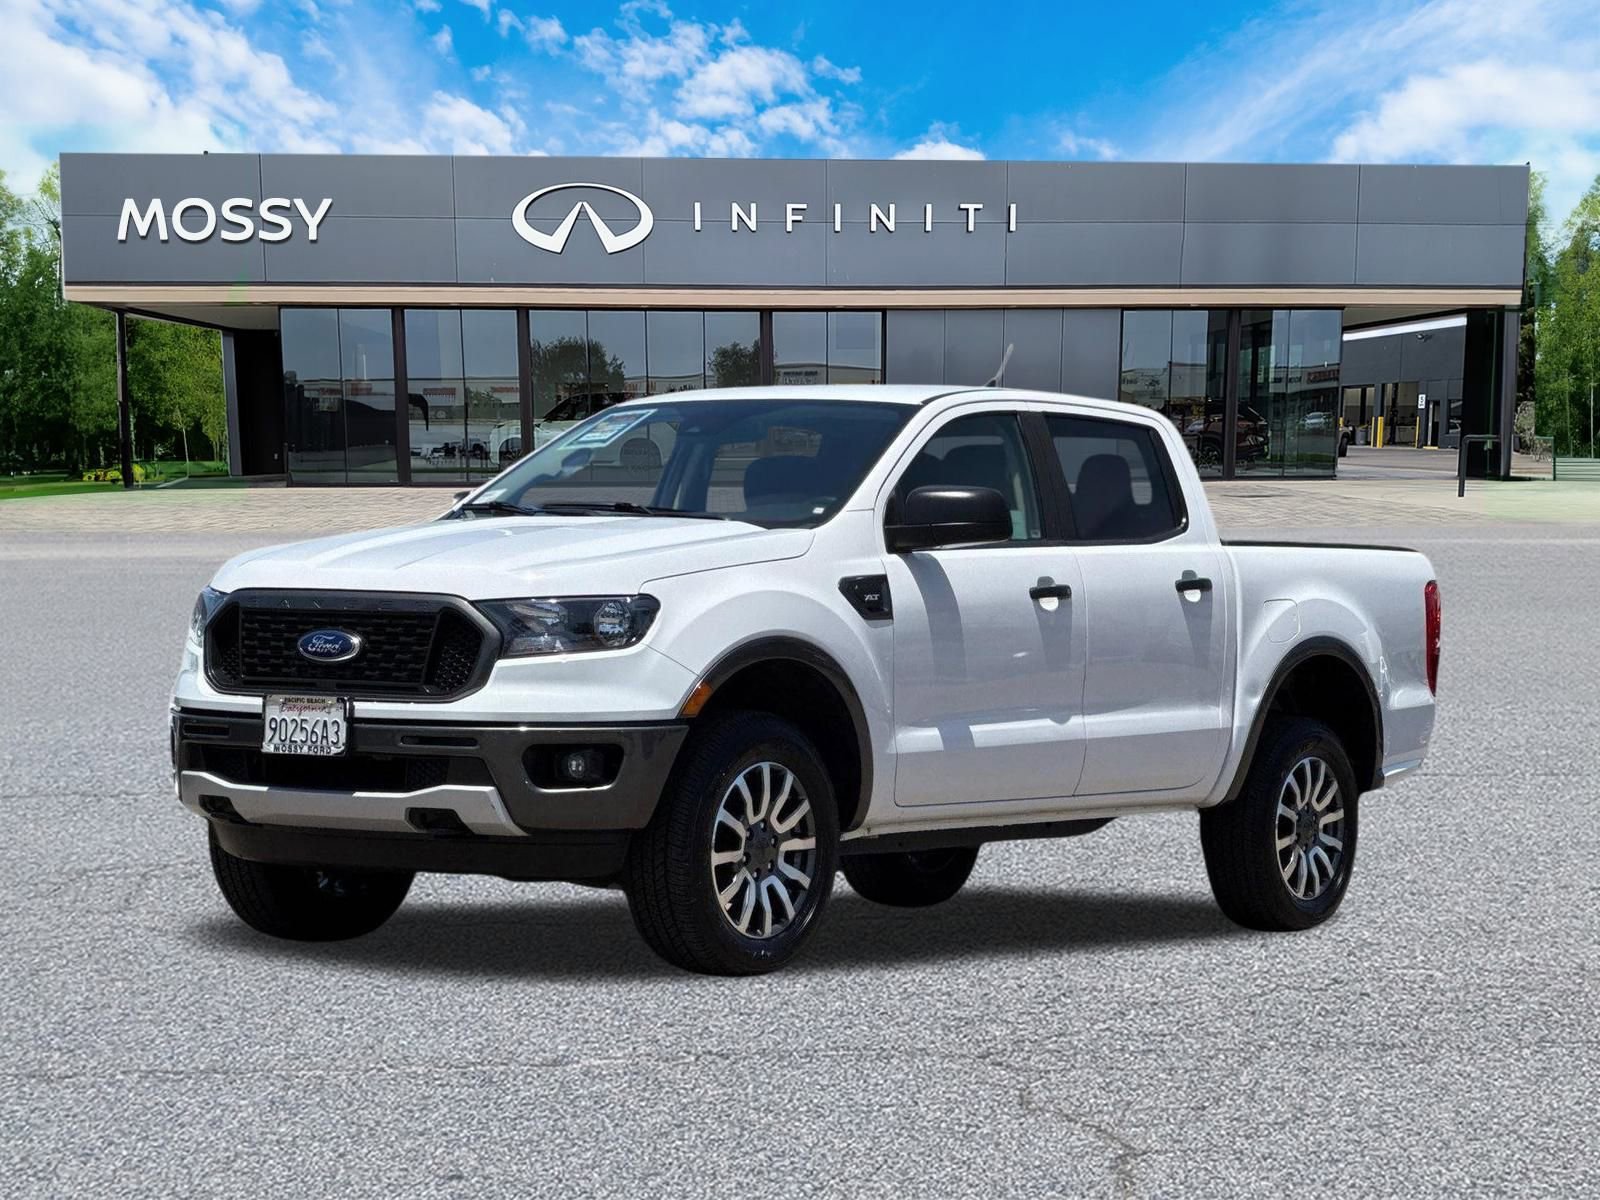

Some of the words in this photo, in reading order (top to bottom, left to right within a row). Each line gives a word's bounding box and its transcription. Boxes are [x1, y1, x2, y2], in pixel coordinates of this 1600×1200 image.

[117, 197, 333, 241] MOSSY
[693, 201, 1017, 233] INFINITI
[307, 634, 343, 653] Ford
[284, 696, 306, 704] PACIFIC
[268, 717, 341, 746] 90256A3
[273, 743, 305, 754] MOSSY
[307, 745, 332, 755] FORD
